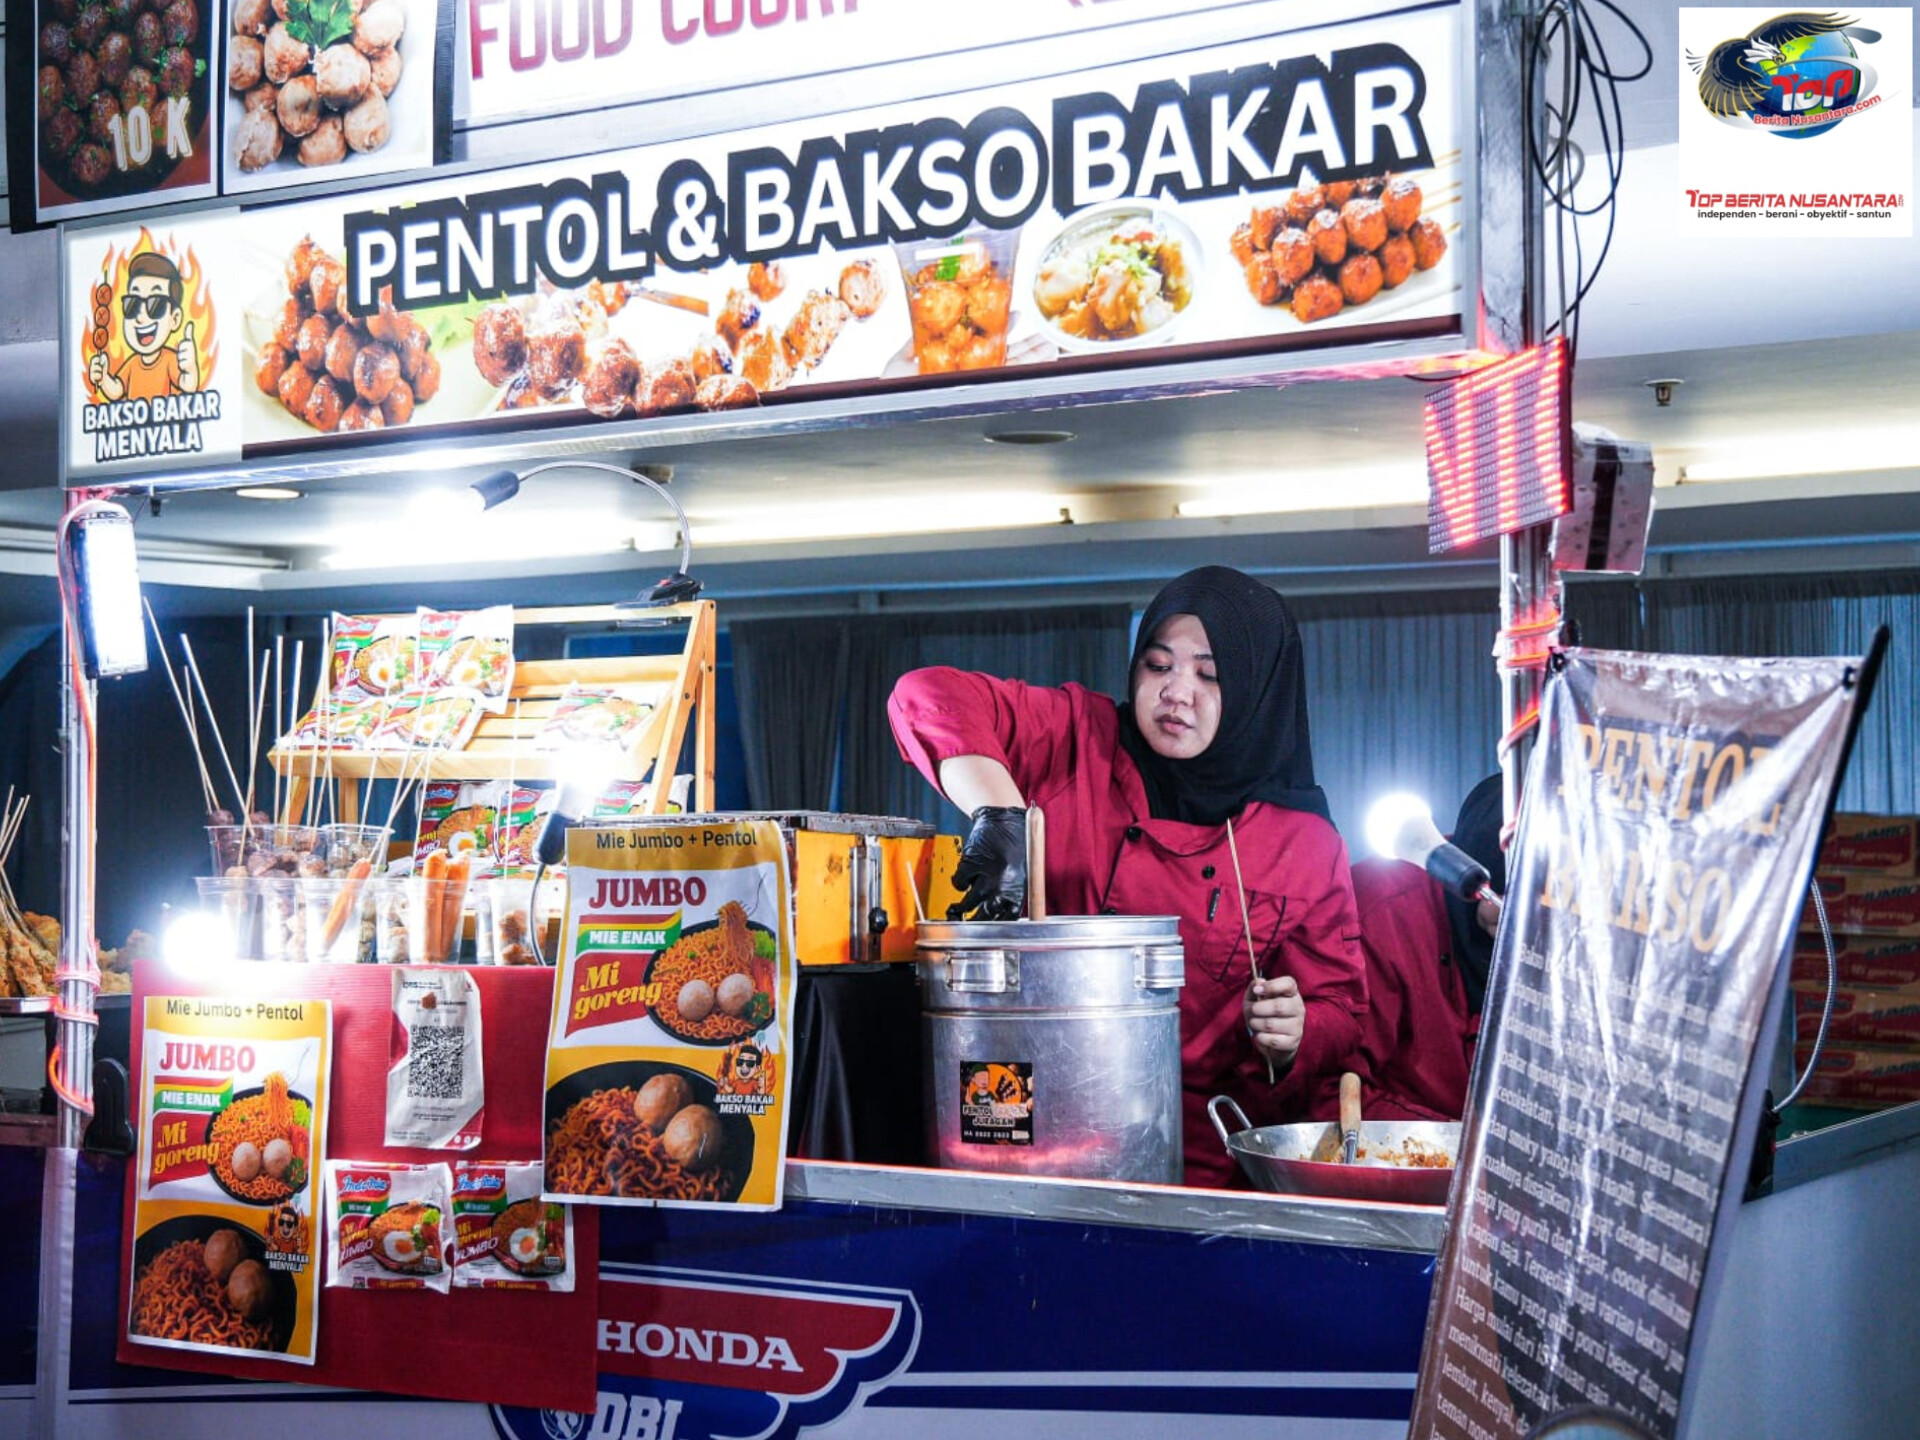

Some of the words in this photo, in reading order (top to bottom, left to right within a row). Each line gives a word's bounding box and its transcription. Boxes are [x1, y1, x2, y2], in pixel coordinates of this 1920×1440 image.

[108, 105, 152, 172] 10
[166, 96, 193, 159] K
[355, 190, 648, 306] PENTOL
[666, 179, 721, 263] &
[743, 128, 1040, 252] BAKSO
[1071, 65, 1421, 206] BAKAR
[83, 397, 150, 432] BAKSO
[151, 390, 220, 423] BAKAR
[97, 420, 201, 461] MENYALA
[597, 832, 625, 849] Mie
[629, 831, 684, 849] Jumbo
[703, 827, 757, 848] Pentol
[588, 876, 708, 909] JUMBO
[589, 930, 620, 945] MIE
[621, 930, 667, 945] ENAK
[579, 961, 622, 993] Mi
[167, 999, 190, 1016] Mie
[194, 1002, 242, 1018] Jumbo
[257, 1003, 304, 1021] Pentol
[573, 982, 663, 1021] goreng
[159, 1042, 256, 1073] JUMBO
[162, 1090, 185, 1104] MIE
[186, 1091, 222, 1107] ENAK
[718, 1103, 766, 1115] MENYALA
[157, 1120, 188, 1149] Mi
[153, 1141, 220, 1175] goreng
[1455, 1285, 1487, 1324] Harga
[597, 1318, 804, 1373] HONDA
